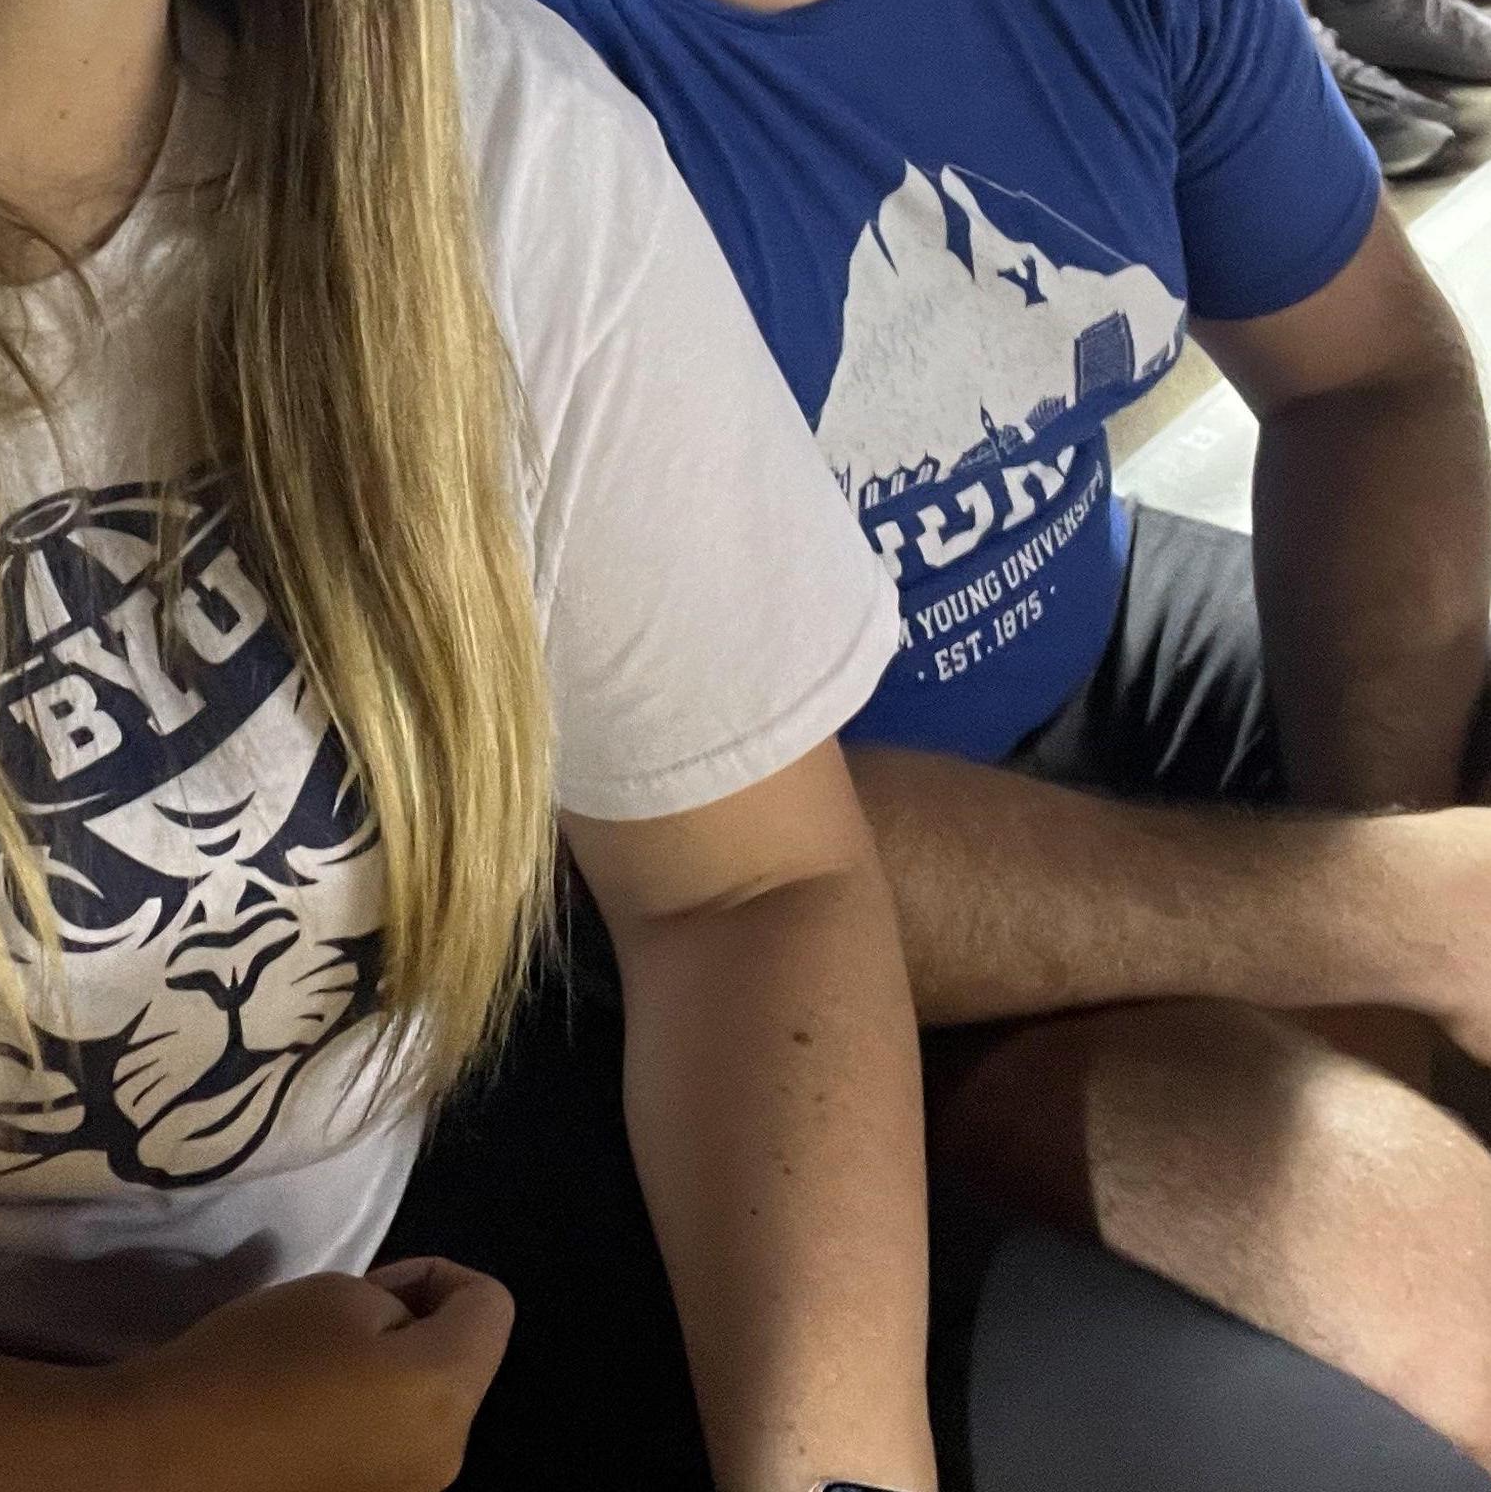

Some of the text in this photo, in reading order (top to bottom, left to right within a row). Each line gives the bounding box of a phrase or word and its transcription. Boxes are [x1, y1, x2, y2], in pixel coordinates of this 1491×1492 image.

[997, 254, 1049, 308] Y
[915, 570, 1003, 640] YOUNG
[1002, 460, 1105, 589] UNIVERSITY
[8, 544, 268, 780] BYU
[934, 629, 993, 682] EST.
[993, 589, 1044, 646] 1875
